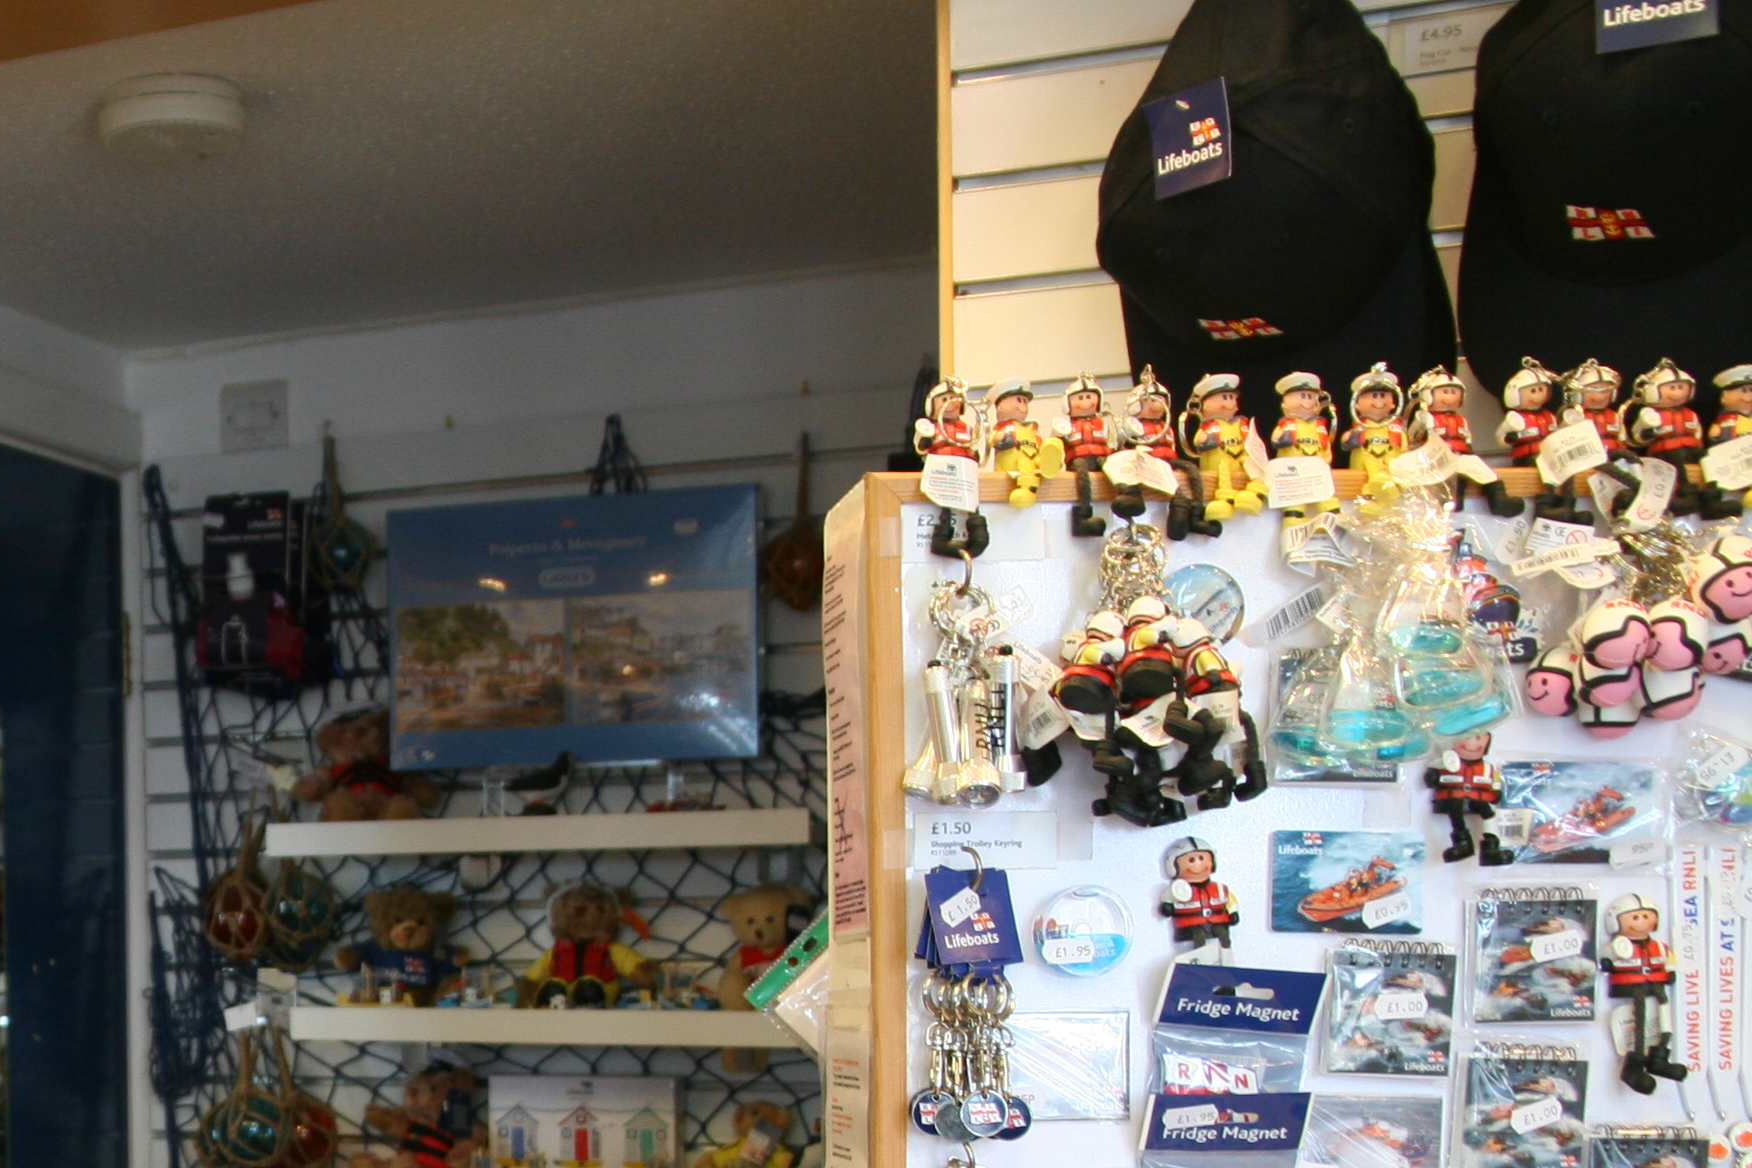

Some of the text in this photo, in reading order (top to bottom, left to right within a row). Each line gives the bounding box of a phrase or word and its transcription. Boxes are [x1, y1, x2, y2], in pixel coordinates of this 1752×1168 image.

[1603, 0, 1707, 29] Lifeboats
[1421, 24, 1463, 42] £4.95
[1156, 140, 1224, 177] Lifeboats
[930, 821, 973, 835] £1.50
[930, 839, 1023, 849] Shopping Trolley Keyring
[1278, 844, 1324, 856] Lifeboats
[943, 932, 1000, 950] Lifeboats
[1542, 938, 1580, 955] £1.00
[1055, 944, 1091, 958] £1.95
[1682, 850, 1702, 1073] SAVING LIVE RNLI
[1387, 1000, 1425, 1014] £1.00
[1718, 930, 1735, 1071] SAVING LIVES AT
[1177, 998, 1300, 1023] Fridge Magnet
[1550, 1006, 1592, 1018] Lifeboats
[1403, 1061, 1446, 1073] Lifeboats
[1176, 1110, 1216, 1125] £1.95
[1523, 1105, 1559, 1125] £1.00
[1162, 1126, 1288, 1144] Fridge Magnet
